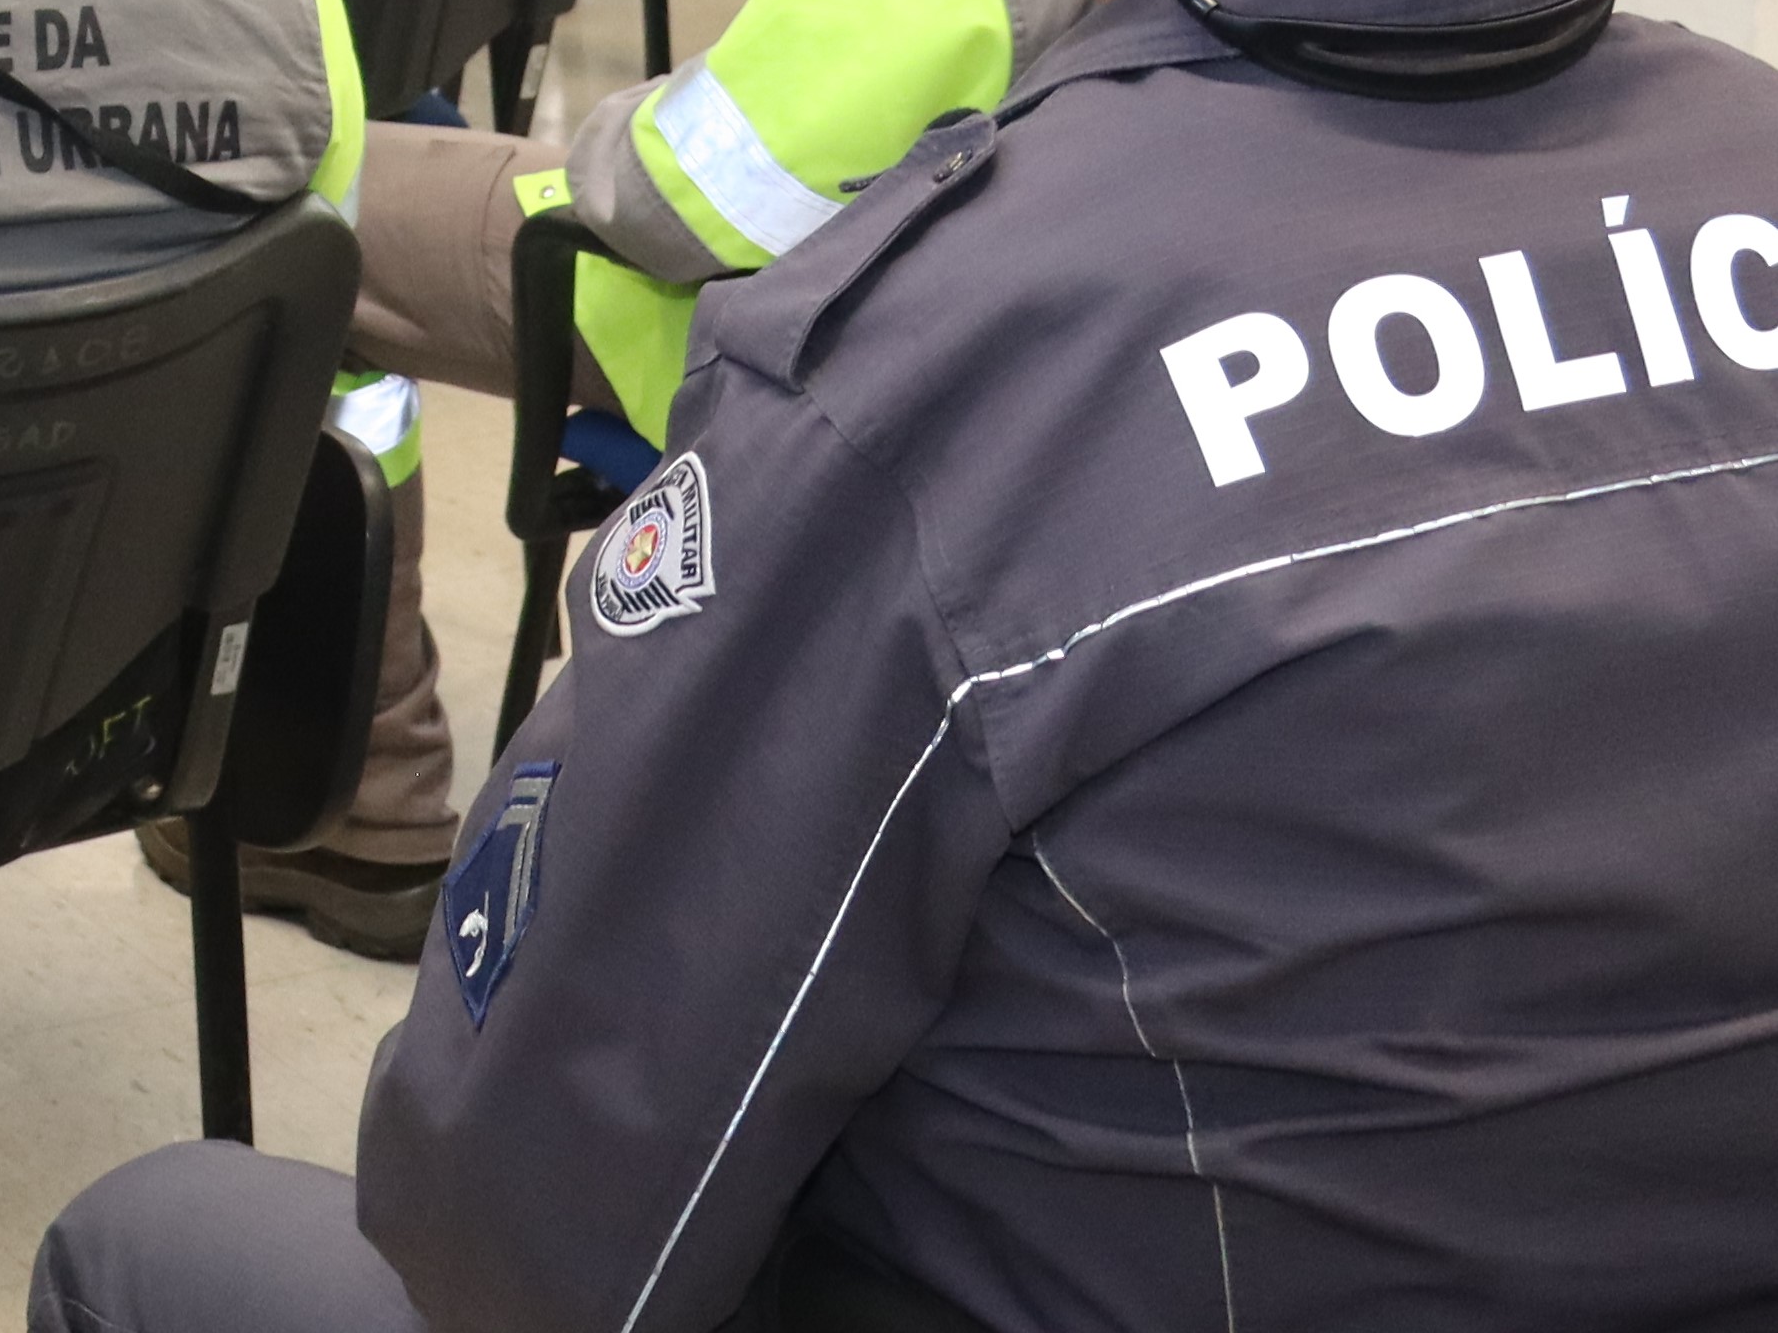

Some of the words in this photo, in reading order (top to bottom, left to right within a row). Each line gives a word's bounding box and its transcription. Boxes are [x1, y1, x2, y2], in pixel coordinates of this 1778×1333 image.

[34, 5, 111, 72] DA
[16, 100, 242, 174] URBANA
[1160, 194, 1778, 488] POLÍC
[681, 485, 699, 579] MILITAR
